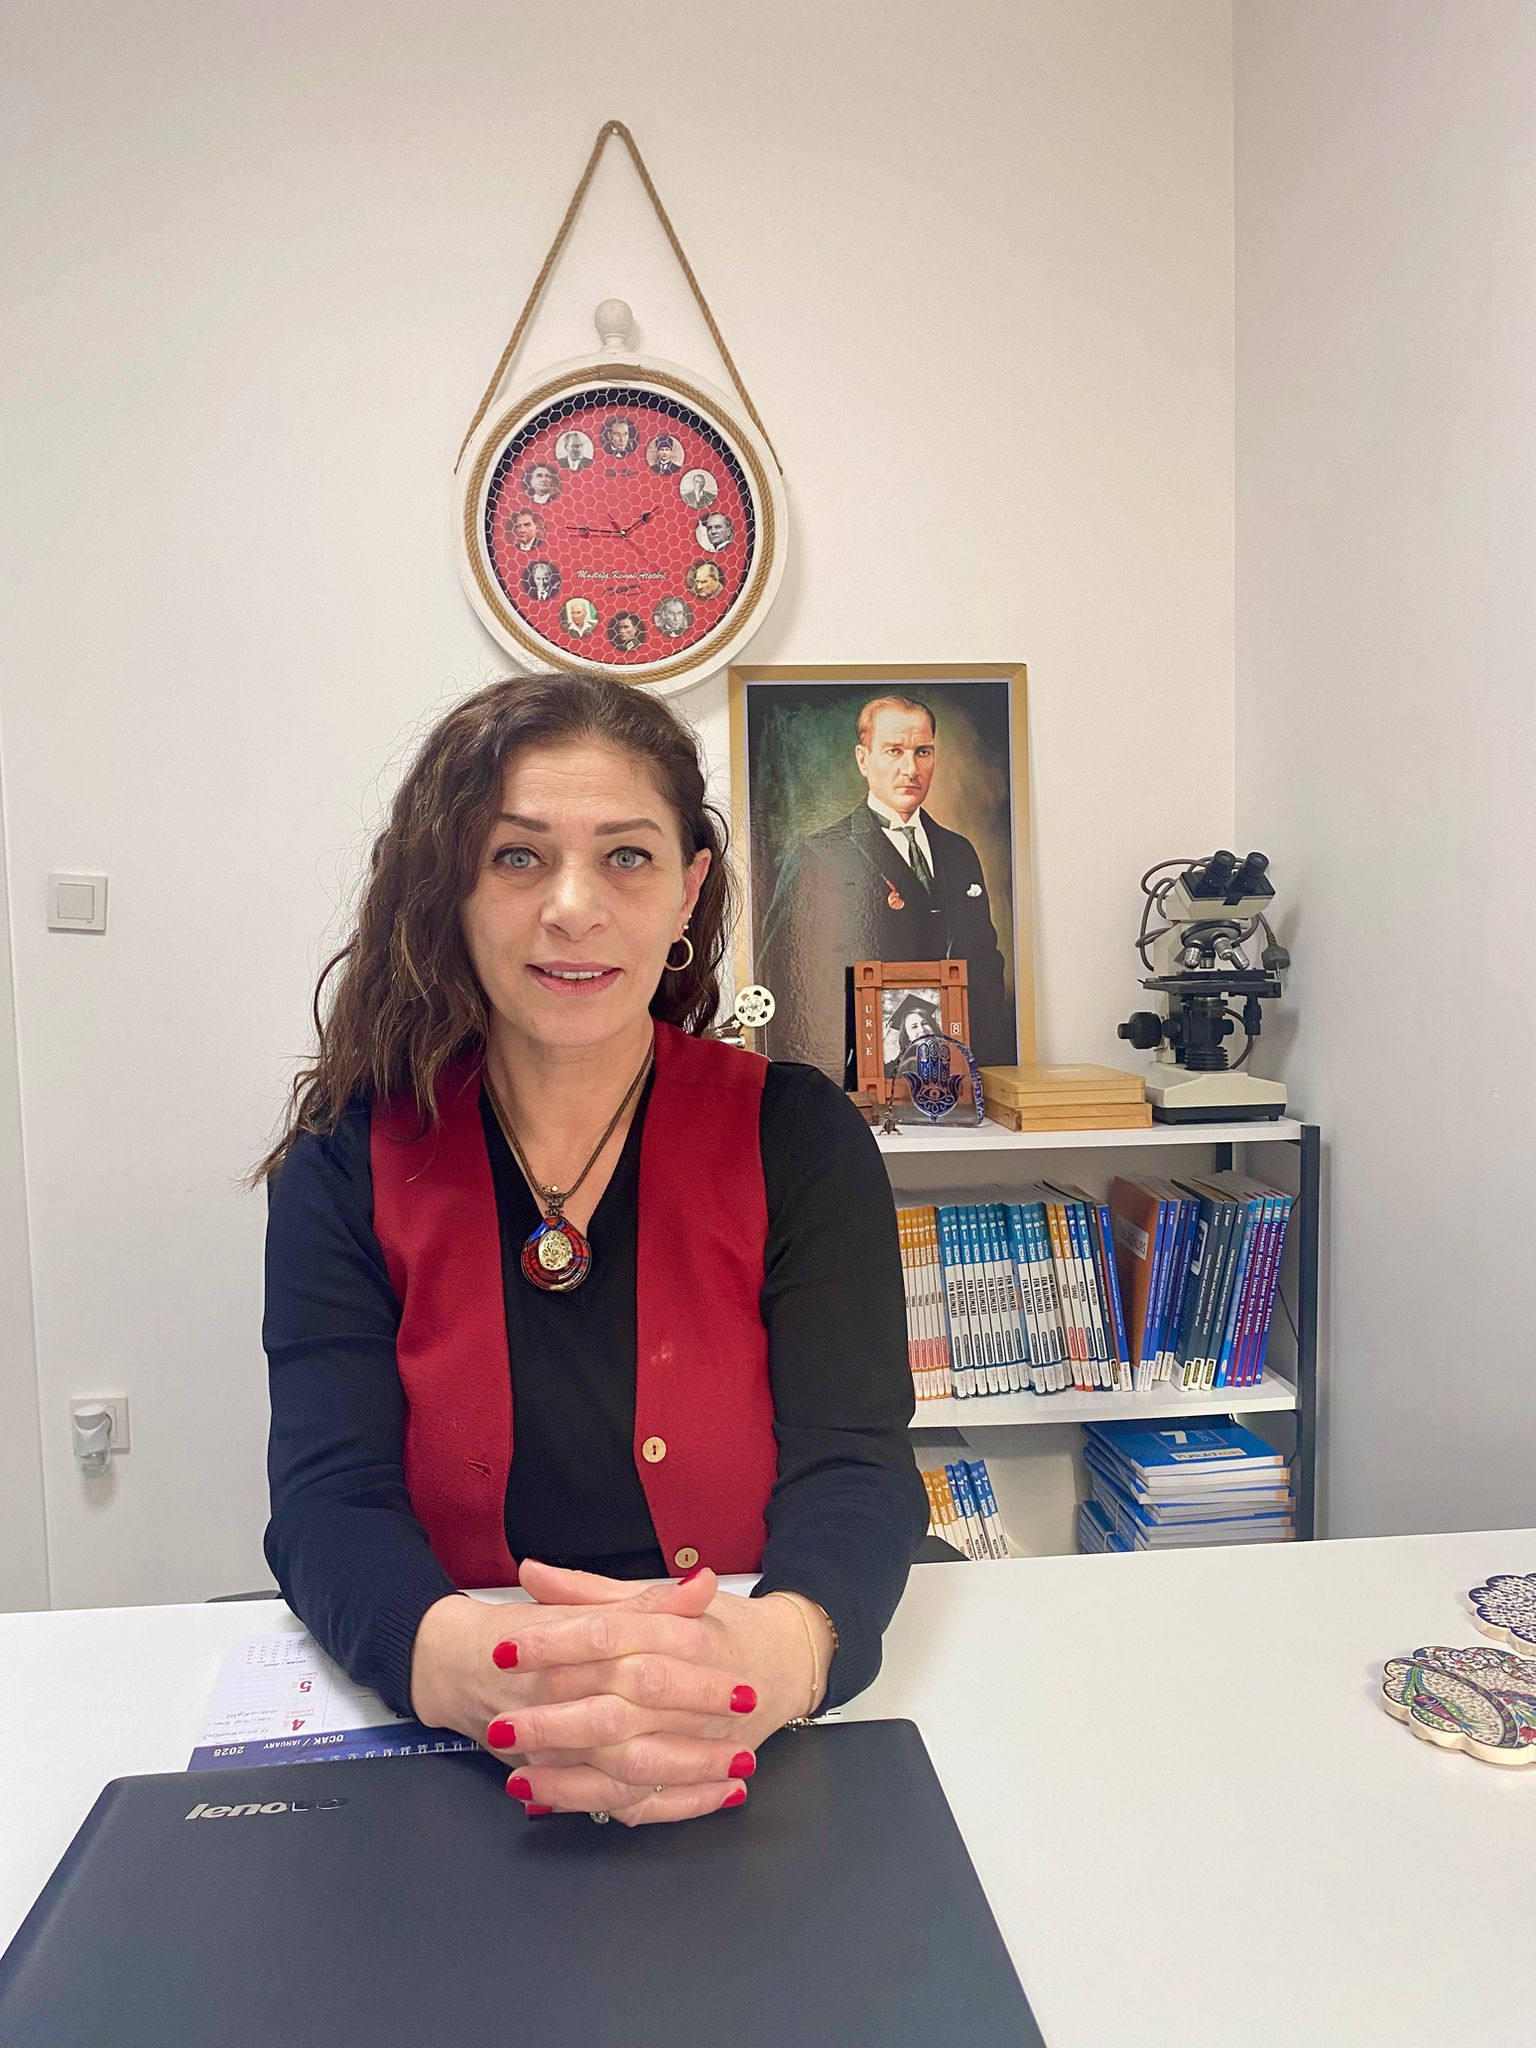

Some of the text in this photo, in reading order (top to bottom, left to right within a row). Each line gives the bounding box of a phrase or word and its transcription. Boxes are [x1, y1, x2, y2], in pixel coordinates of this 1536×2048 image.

[300, 1681, 312, 1693] 5
[292, 1719, 305, 1731] 4
[264, 1739, 301, 1749] JANUARY
[314, 1734, 344, 1744] OCAK
